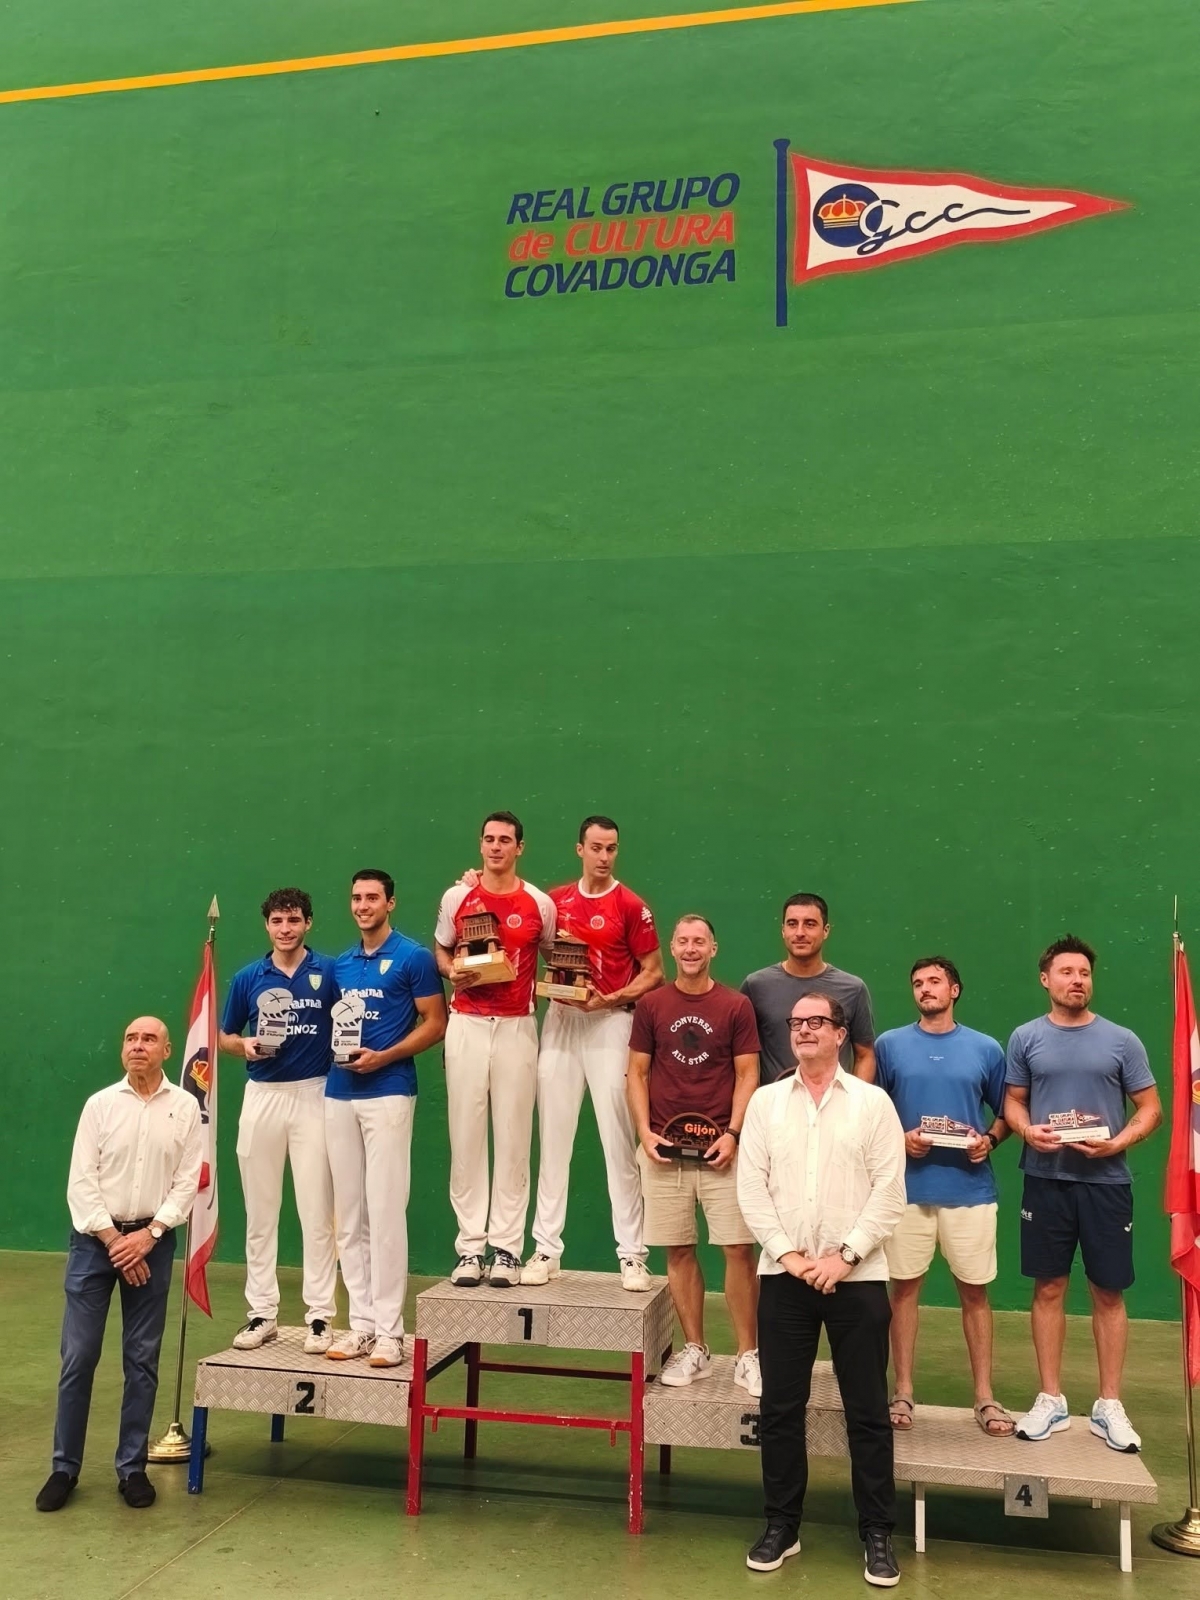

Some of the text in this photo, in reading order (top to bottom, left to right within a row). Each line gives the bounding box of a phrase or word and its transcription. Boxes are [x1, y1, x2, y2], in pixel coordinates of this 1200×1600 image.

[506, 172, 741, 225] REAL GRUPO
[508, 211, 736, 263] de CULTURA
[504, 249, 737, 299] COVADONGA
[670, 1016, 714, 1035] CONVERSE
[671, 1049, 710, 1066] ALL STAR
[684, 1123, 716, 1137] Gijón
[517, 1307, 533, 1340] 1
[295, 1381, 315, 1414] 2
[740, 1413, 761, 1446] 3
[1014, 1484, 1033, 1507] 4
